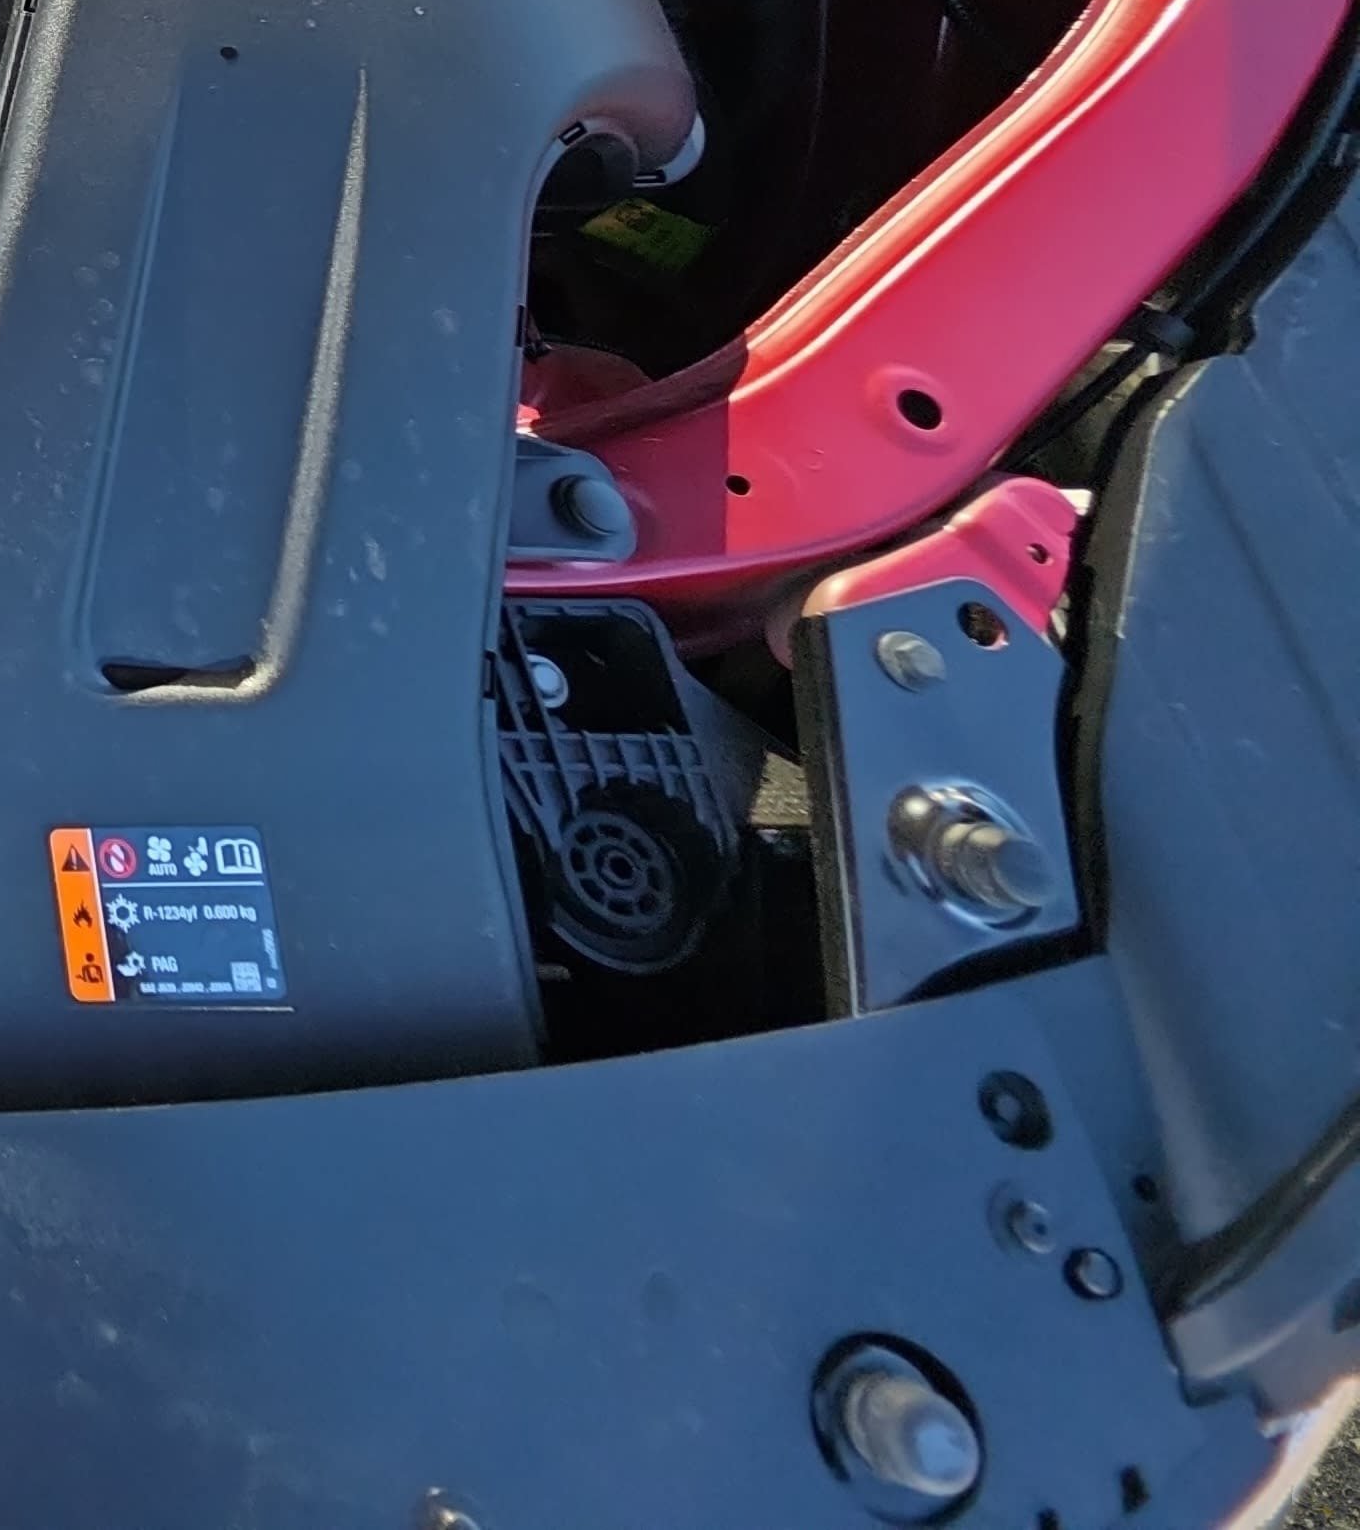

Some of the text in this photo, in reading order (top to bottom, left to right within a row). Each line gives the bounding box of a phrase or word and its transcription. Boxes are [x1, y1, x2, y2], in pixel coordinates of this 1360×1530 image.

[148, 863, 178, 876] AUTO
[239, 905, 257, 922] kg
[151, 956, 179, 973] PAG
